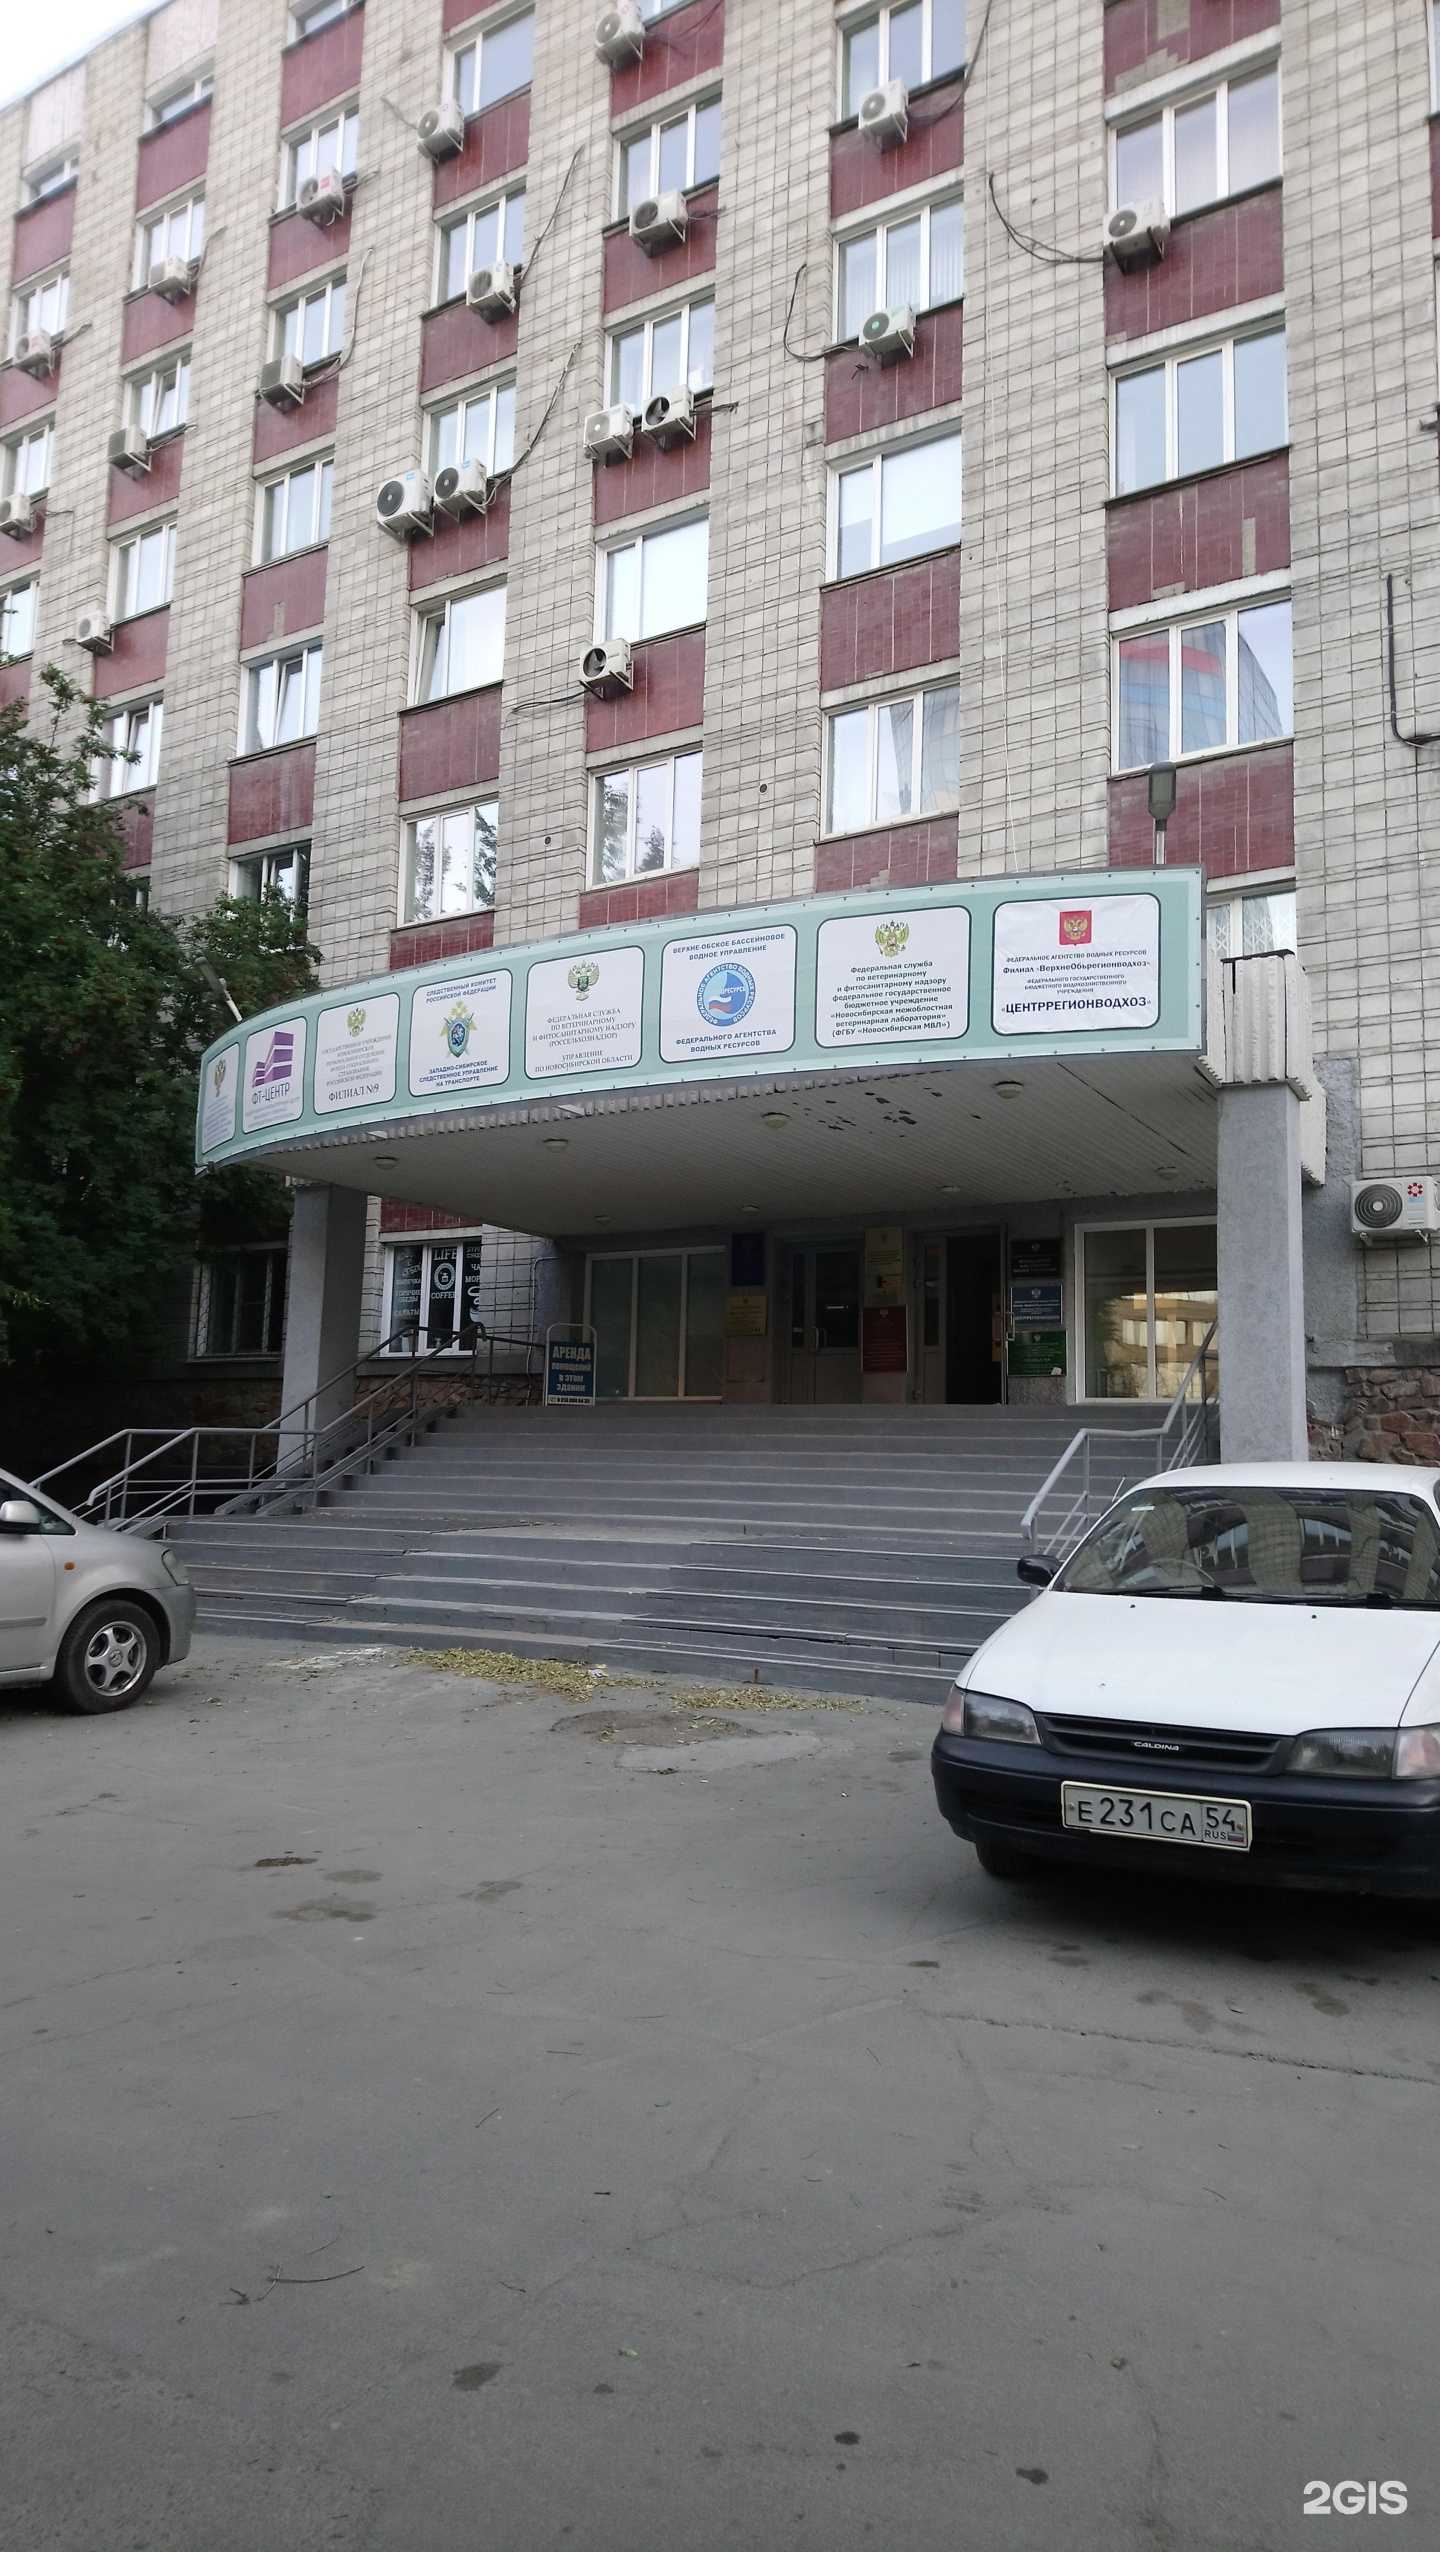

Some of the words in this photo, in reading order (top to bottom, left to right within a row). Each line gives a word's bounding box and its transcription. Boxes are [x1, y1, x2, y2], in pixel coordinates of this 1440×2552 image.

[731, 933, 785, 946] БАССЕЙНОВОЕ
[689, 951, 718, 960] ВОДНОЕ
[720, 945, 767, 957] УПРАВЛЕНИЕ
[1006, 955, 1050, 963] ФЕДЕРАЛЬНОЕ
[1051, 952, 1085, 960] АГЕНТСТВО
[1114, 949, 1147, 957] РЕСУРСОВ
[851, 963, 902, 973] Федеральная
[904, 961, 933, 970] служба
[1003, 966, 1034, 974] Филиал
[868, 971, 927, 981] ветеринарному
[1027, 976, 1069, 984] ФЕДЕРАЛЬНОГО
[1070, 974, 1124, 982] ГОСУДАРСТВЕННОГО
[426, 983, 469, 997] СЛЕДСТВЕННЫЙ
[471, 978, 496, 988] КОМИТЕТ
[844, 979, 912, 993] фитосанитарному
[914, 977, 947, 986] надзору
[1056, 987, 1094, 995] УЧРЕЖДЕНИЯ
[1063, 980, 1127, 988] ВОДОХОЗЯЙСТВЕННОГО
[426, 992, 461, 1004] РОССИЙСКОЙ
[463, 985, 496, 996] ФЕДЕРАЦИИ
[833, 991, 883, 1002] федеральное
[885, 986, 951, 997] государственное
[844, 999, 888, 1010] бюджетное
[890, 995, 938, 1006] учреждение
[1001, 997, 1152, 1015] «ЦЕНТРРЕГИОНВОДХОЗ»
[547, 1012, 592, 1023] ФЕДЕРАЛЬНАЯ
[593, 1008, 622, 1018] СЛУЖБА
[831, 1009, 893, 1019] «Новосибирская
[836, 1017, 889, 1028] ветеринарная
[890, 1013, 946, 1023] лаборатория»
[539, 1026, 604, 1040] ФИТОСАНИТАРНОМУ
[605, 1022, 635, 1032] НАДЗОРУ
[562, 1017, 615, 1030] ВЕТЕРИНАРНОМУ
[832, 1028, 856, 1038] (ФГБУ
[857, 1024, 922, 1034] «Новосибирская
[923, 1020, 951, 1030] МВЛ»)
[676, 1033, 733, 1045] ФЕДЕРАЛЬНОГО
[734, 1029, 777, 1039] АГЕНТСТВА
[690, 1043, 722, 1053] ВОДНЫХ
[723, 1040, 760, 1049] РЕСУРСОВ
[545, 1058, 601, 1071] НОВОСИБИРСКОЙ
[602, 1055, 633, 1065] ОБЛАСТИ
[562, 1050, 603, 1061] УПРАВЛЕНИЕ
[419, 1071, 461, 1083] СЛЕДСТВЕННОЕ
[462, 1066, 498, 1077] УПРАВЛЕНИЕ
[429, 1060, 488, 1075] ЗАПАДНО-СИБИРСКОЕ
[445, 1076, 480, 1086] ТРАНСПОРТЕ
[252, 1082, 290, 1104] ФТ-ЦЕНТР
[328, 1086, 364, 1101] ФИЛИАЛ
[552, 1346, 591, 1361] АРЕНДА
[565, 1374, 584, 1383] ЭТОМ
[1133, 1741, 1180, 1751] CALDINA
[1206, 1807, 1237, 1831] 54
[1204, 1829, 1228, 1841] RUS
